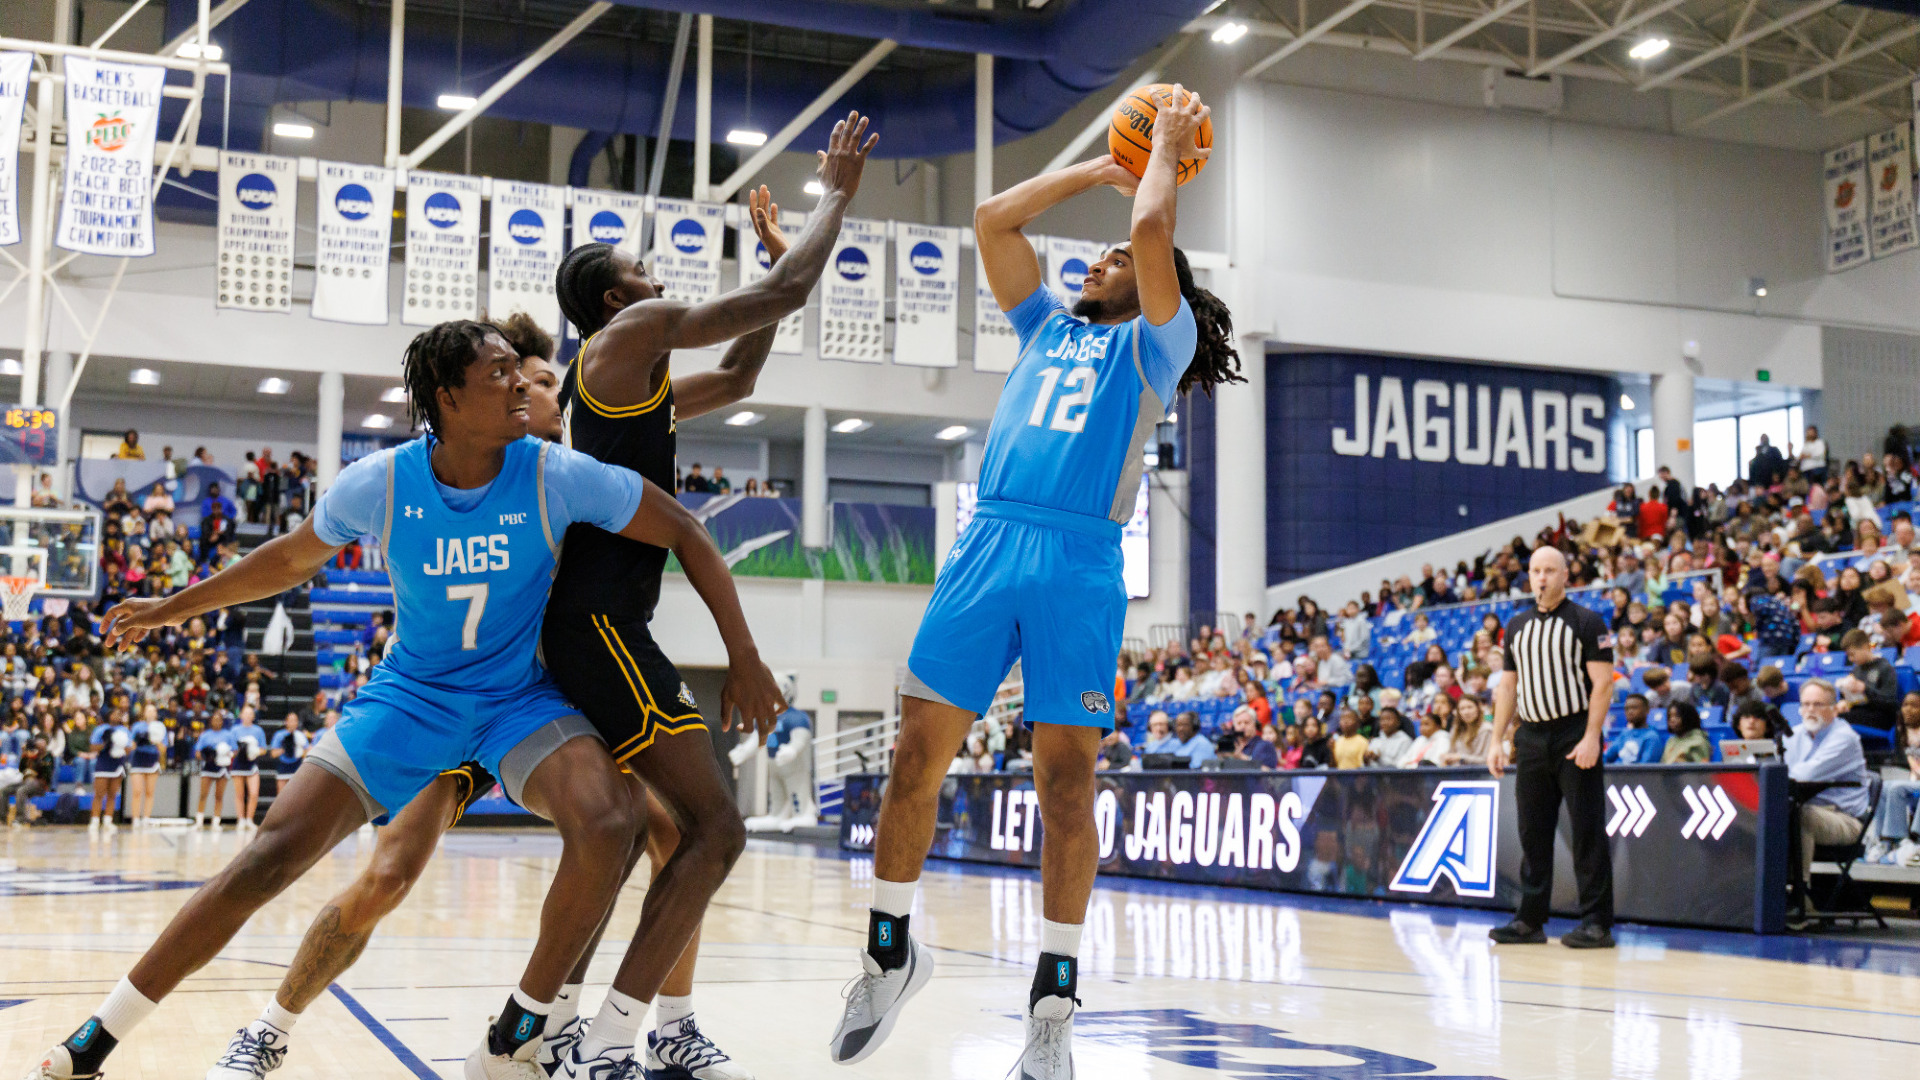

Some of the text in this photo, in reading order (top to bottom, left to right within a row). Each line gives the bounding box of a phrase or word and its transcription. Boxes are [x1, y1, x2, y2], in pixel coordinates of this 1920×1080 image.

[95, 69, 135, 87] MEN'S
[74, 83, 156, 107] BASKETBALL
[81, 155, 141, 176] 2022-23
[73, 171, 110, 190] PEACH
[73, 209, 142, 229] TOURNAMENT
[69, 227, 145, 248] CHAMPIONS
[1046, 333, 1111, 362] JAGS
[1028, 365, 1098, 433] 12
[1332, 374, 1605, 473] JAGUARS
[499, 512, 527, 526] PBC
[423, 534, 510, 576] JAGS
[446, 582, 490, 651] 7
[990, 789, 1042, 852] LET
[1124, 790, 1302, 873] JAGUARS
